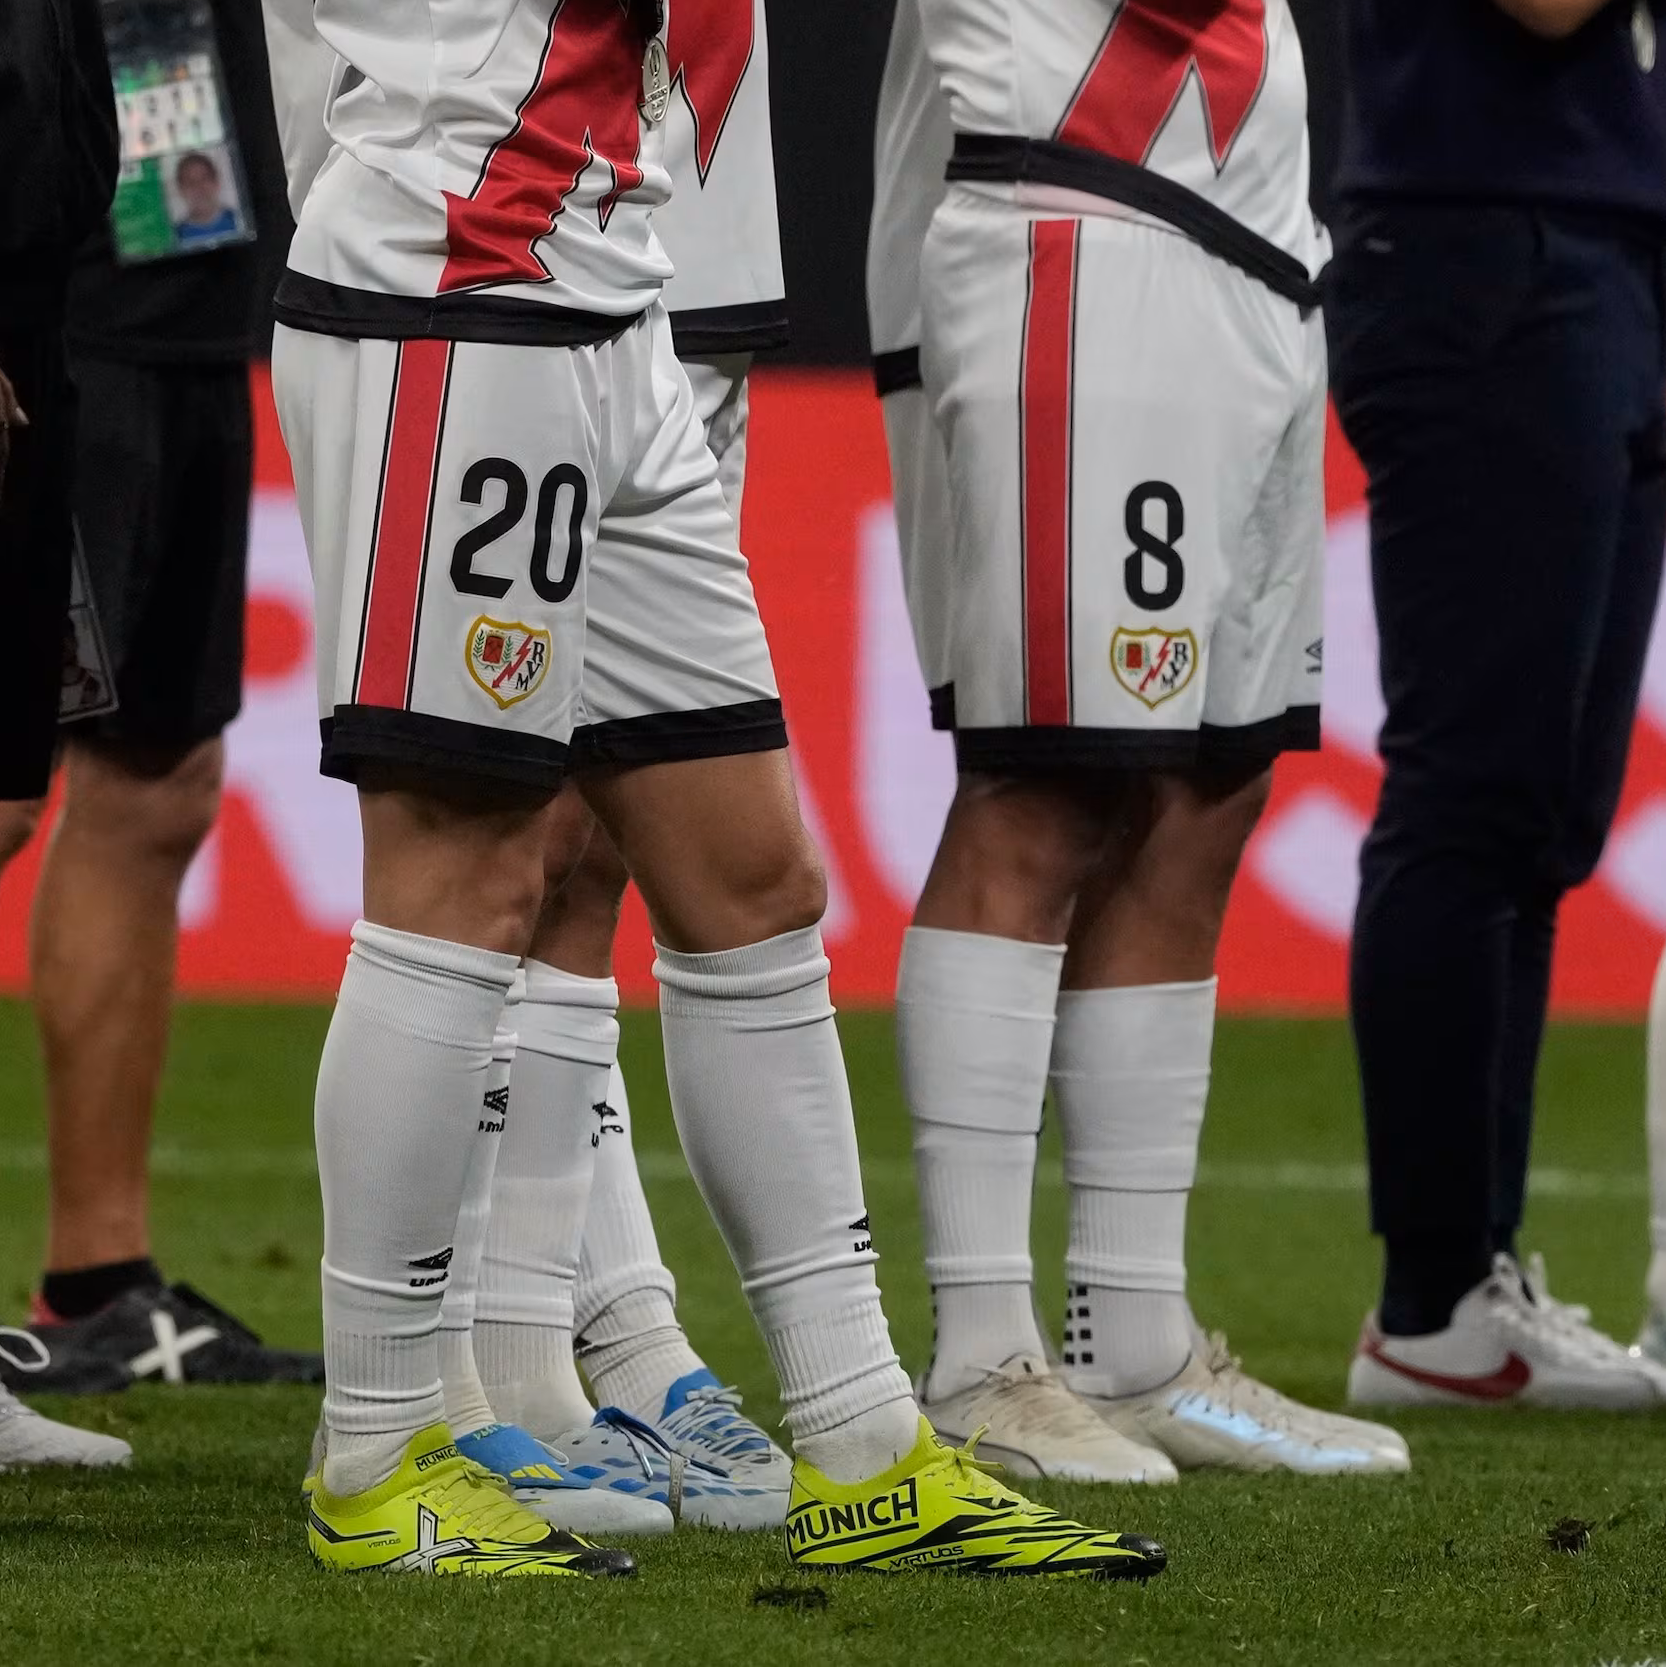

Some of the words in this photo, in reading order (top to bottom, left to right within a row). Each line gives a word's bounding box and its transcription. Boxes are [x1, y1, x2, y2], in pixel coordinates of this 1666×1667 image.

[449, 457, 588, 603] 20
[1125, 480, 1184, 611] 8
[786, 1477, 919, 1545] MUNICH
